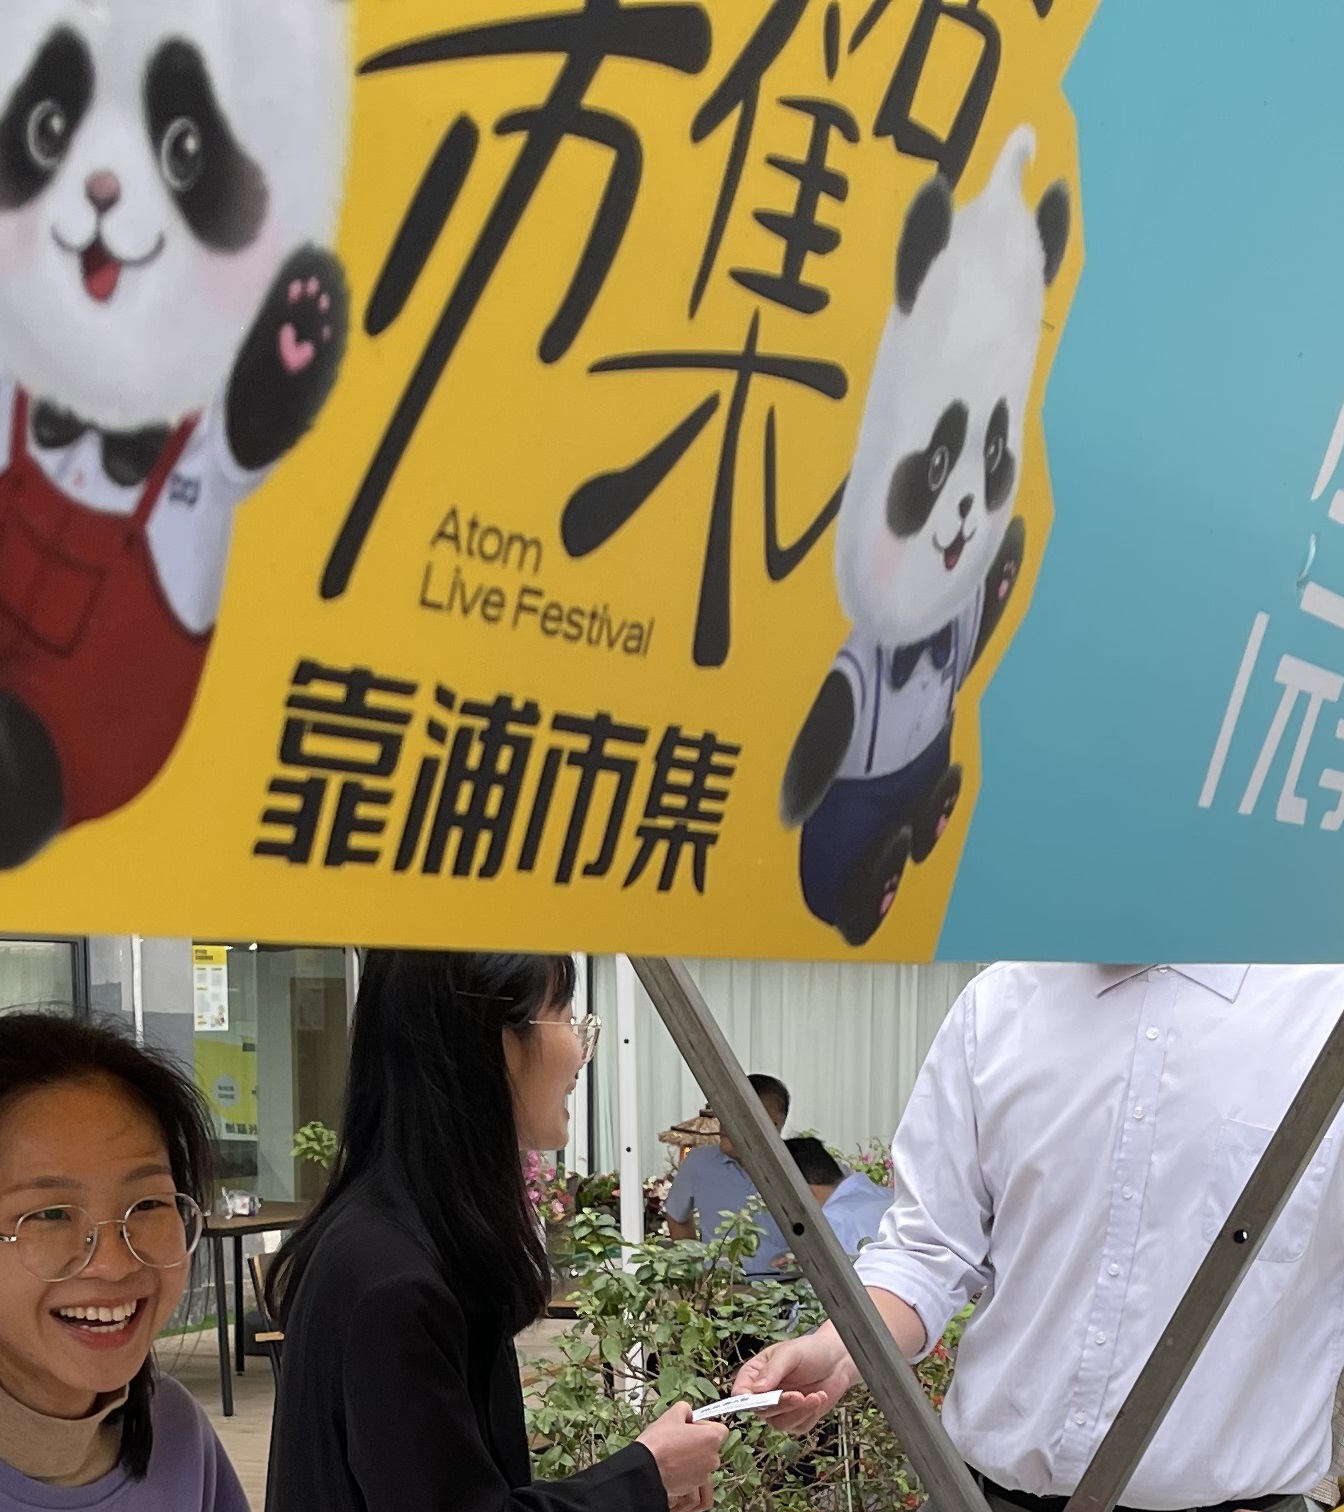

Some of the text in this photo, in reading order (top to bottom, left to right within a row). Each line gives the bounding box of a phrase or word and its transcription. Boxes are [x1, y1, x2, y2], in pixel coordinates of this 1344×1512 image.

[430, 505, 544, 575] Atom
[419, 562, 656, 658] Live Festival
[253, 660, 742, 897] 靠浦市集
